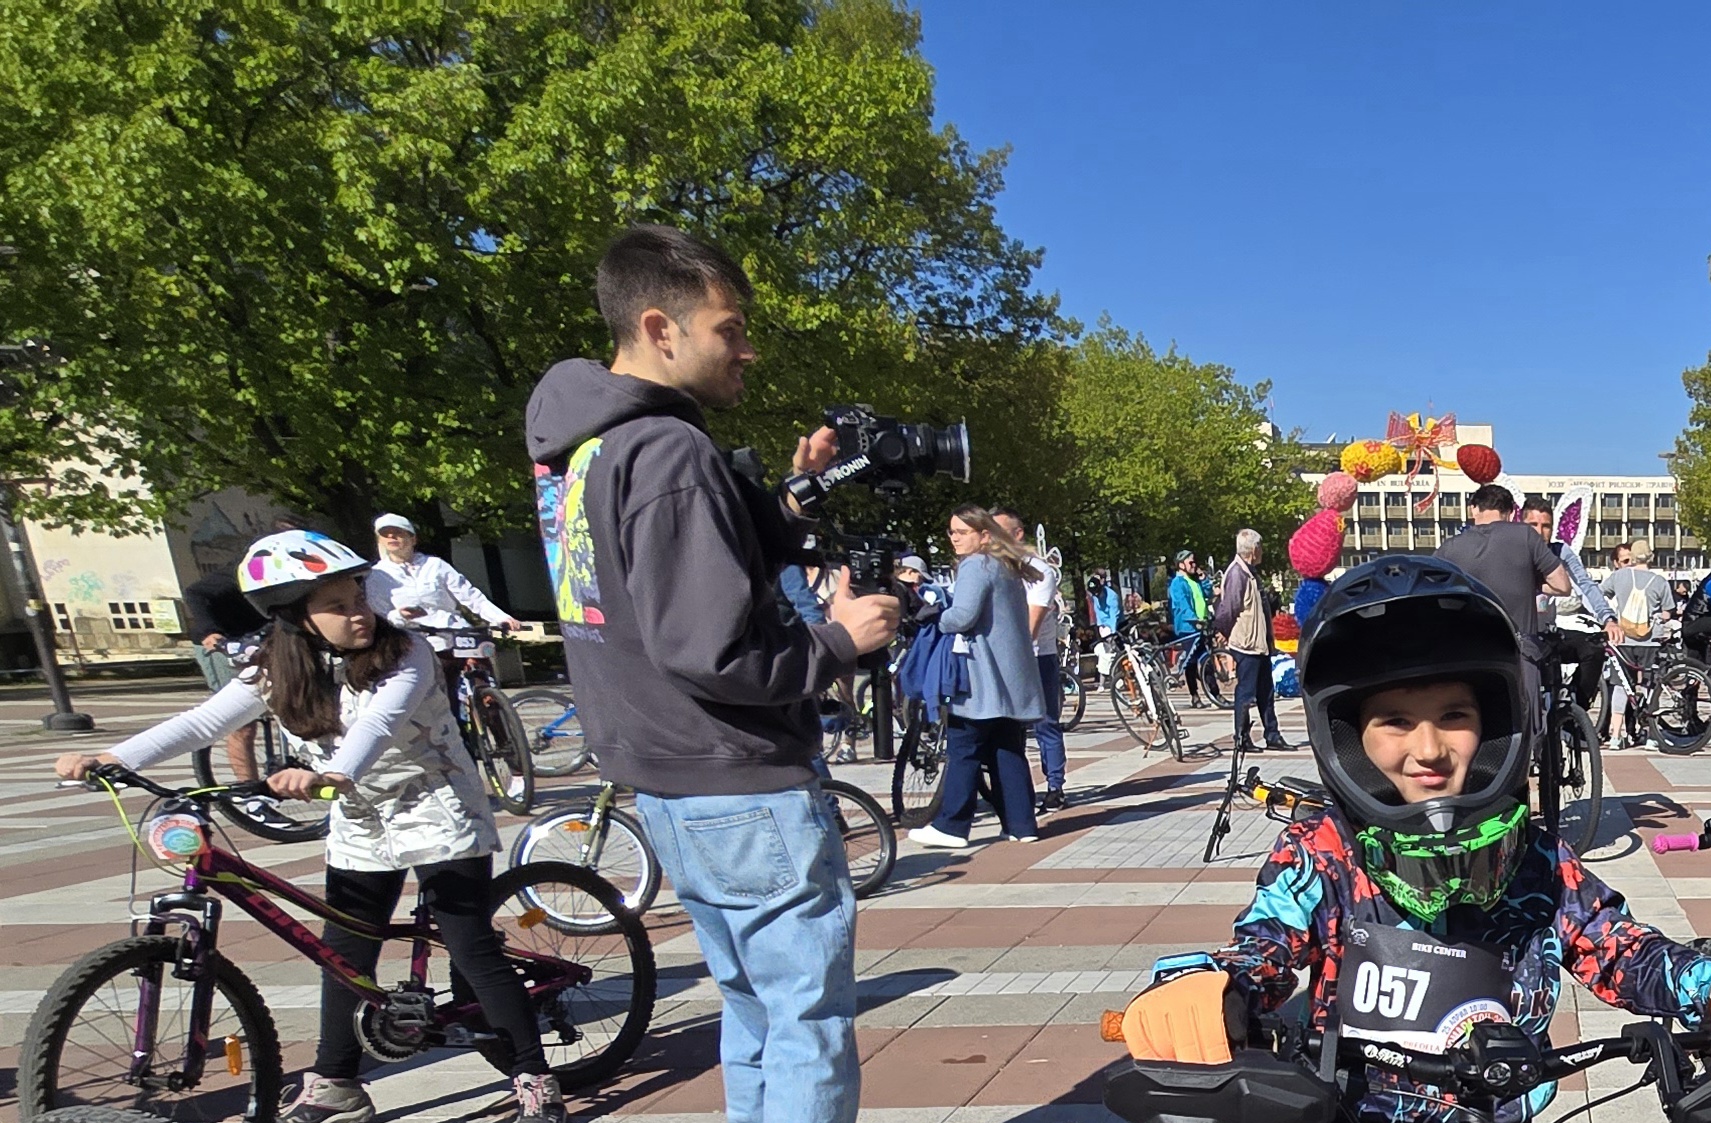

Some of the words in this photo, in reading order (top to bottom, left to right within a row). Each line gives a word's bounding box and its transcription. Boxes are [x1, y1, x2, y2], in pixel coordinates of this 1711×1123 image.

[833, 454, 871, 481] RONIN
[1390, 479, 1430, 487] BULARIA
[1411, 942, 1433, 953] BIKE
[1433, 945, 1467, 959] CENTER
[1352, 960, 1431, 1022] 057
